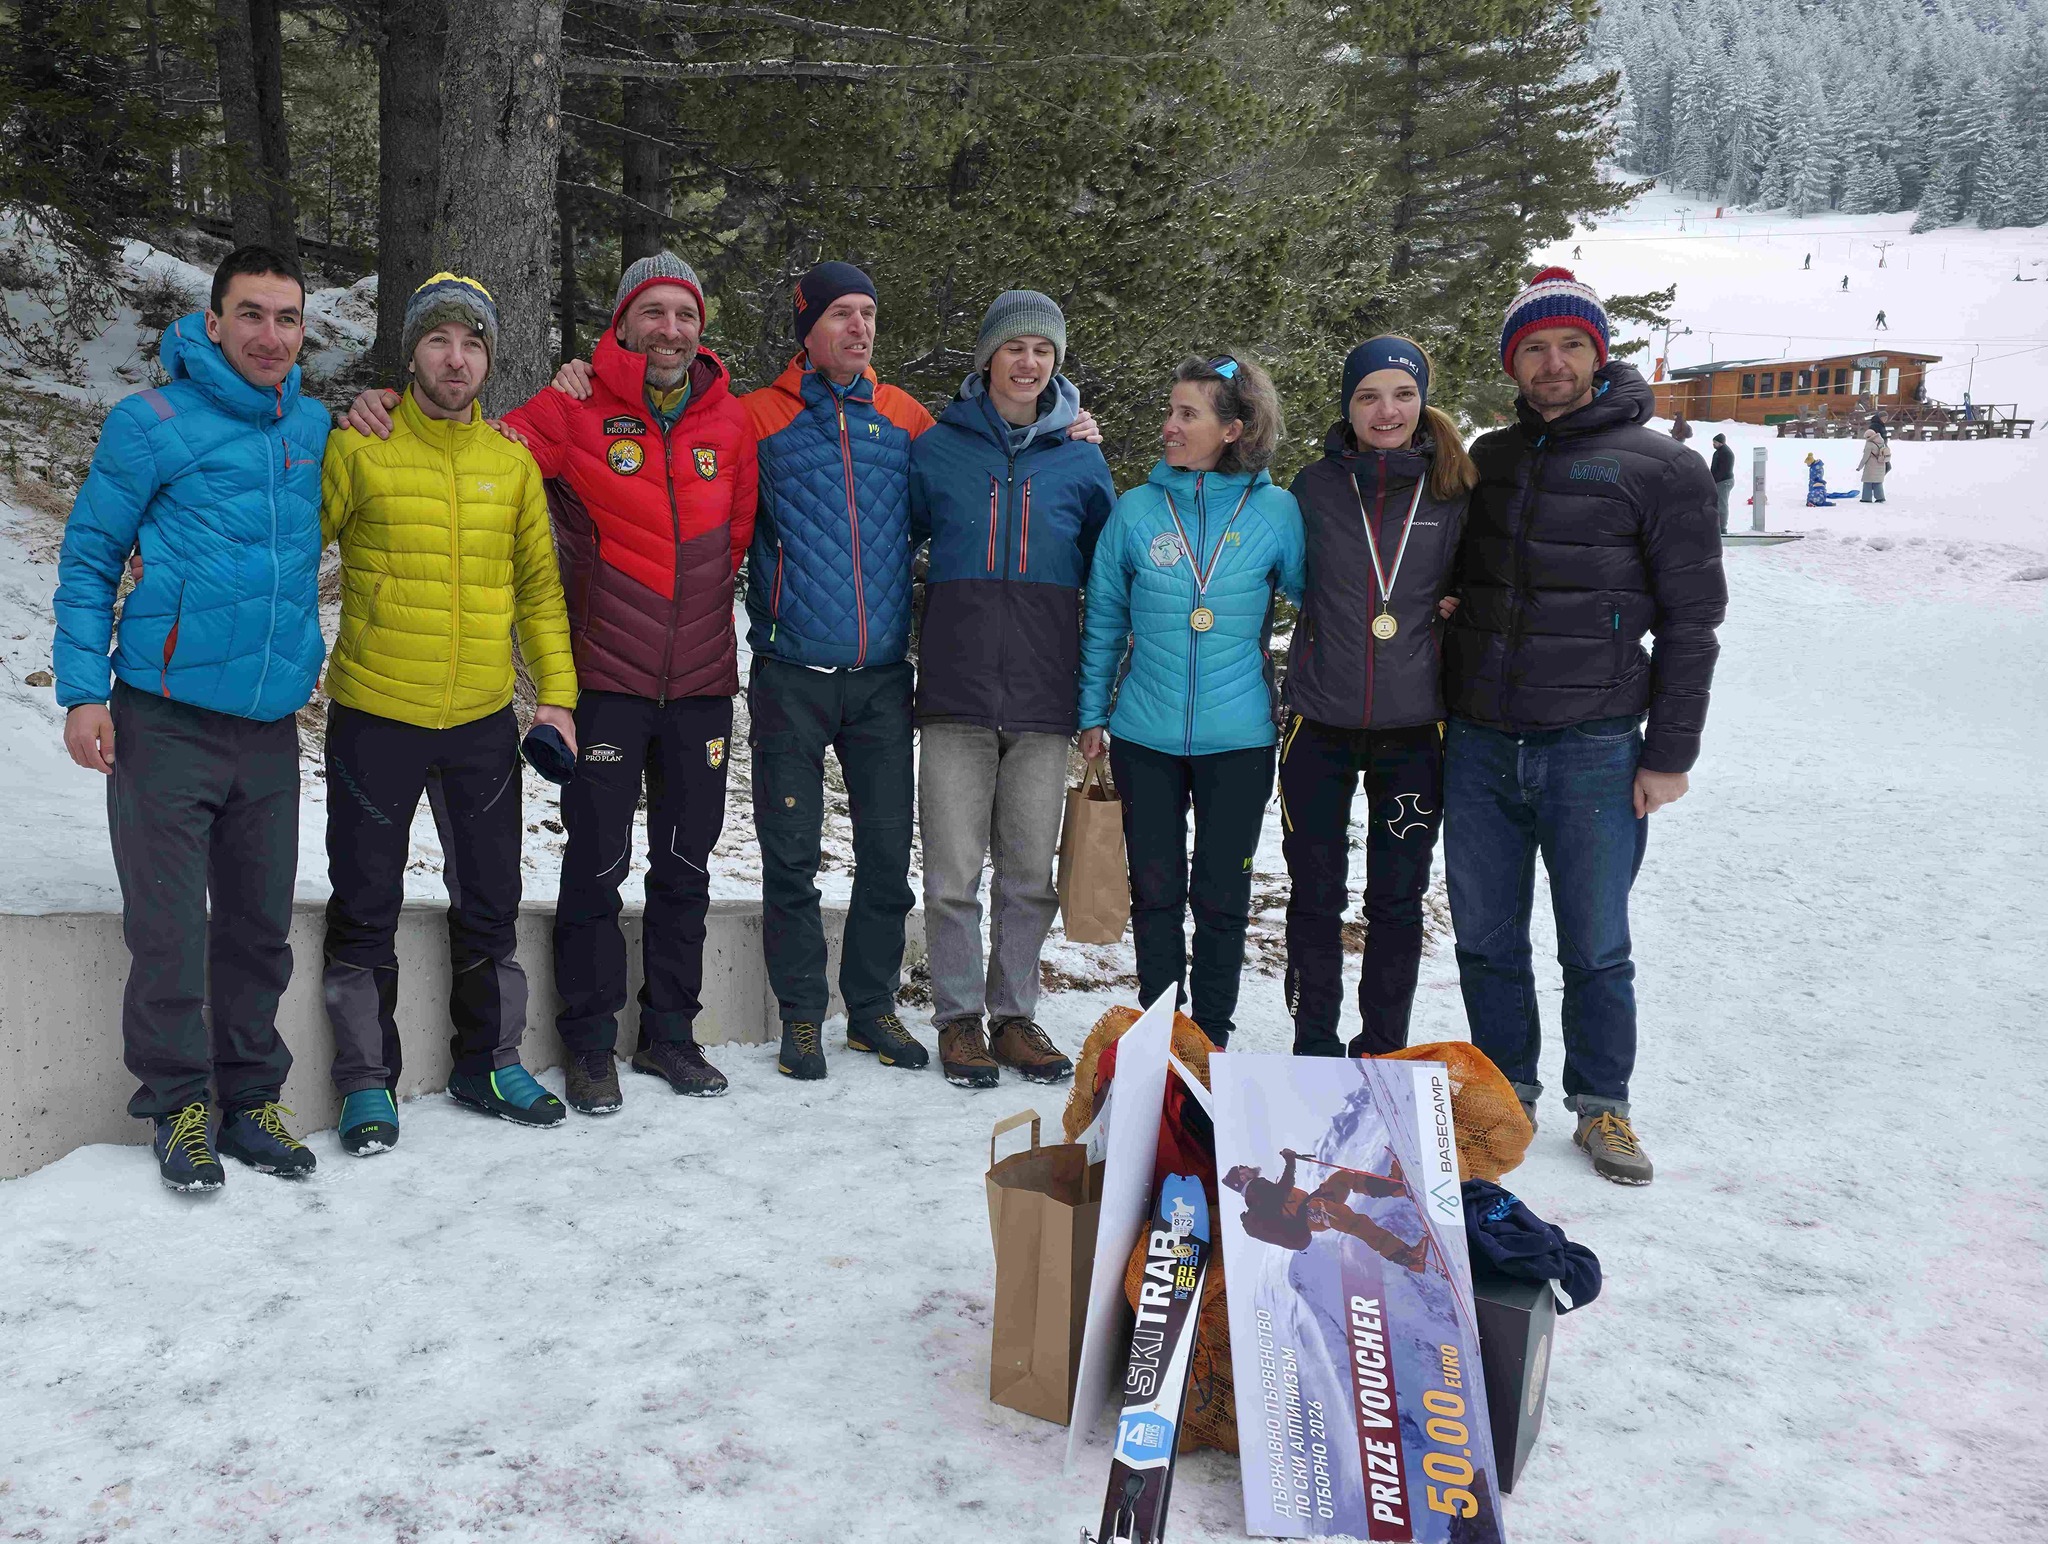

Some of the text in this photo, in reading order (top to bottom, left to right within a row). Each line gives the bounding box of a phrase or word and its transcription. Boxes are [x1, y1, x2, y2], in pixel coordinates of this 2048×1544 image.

[1388, 355, 1419, 374] LEKI
[1570, 464, 1620, 483] MINI
[361, 1125, 379, 1134] LINE
[1431, 1076, 1453, 1173] BASECAMP
[1174, 1218, 1193, 1227] 872
[1124, 1230, 1181, 1397] SKITRAB
[1257, 1309, 1292, 1519] ДЪРЖАВНО ПЪРВЕНСТВО
[1281, 1347, 1312, 1518] ПО СКИ АЛПИНИЗЪМ
[1307, 1400, 1334, 1519] ОТБОРНО 2026
[1351, 1295, 1405, 1526] PRIZE VOUCHER
[1422, 1344, 1479, 1519] 50.00 EURO
